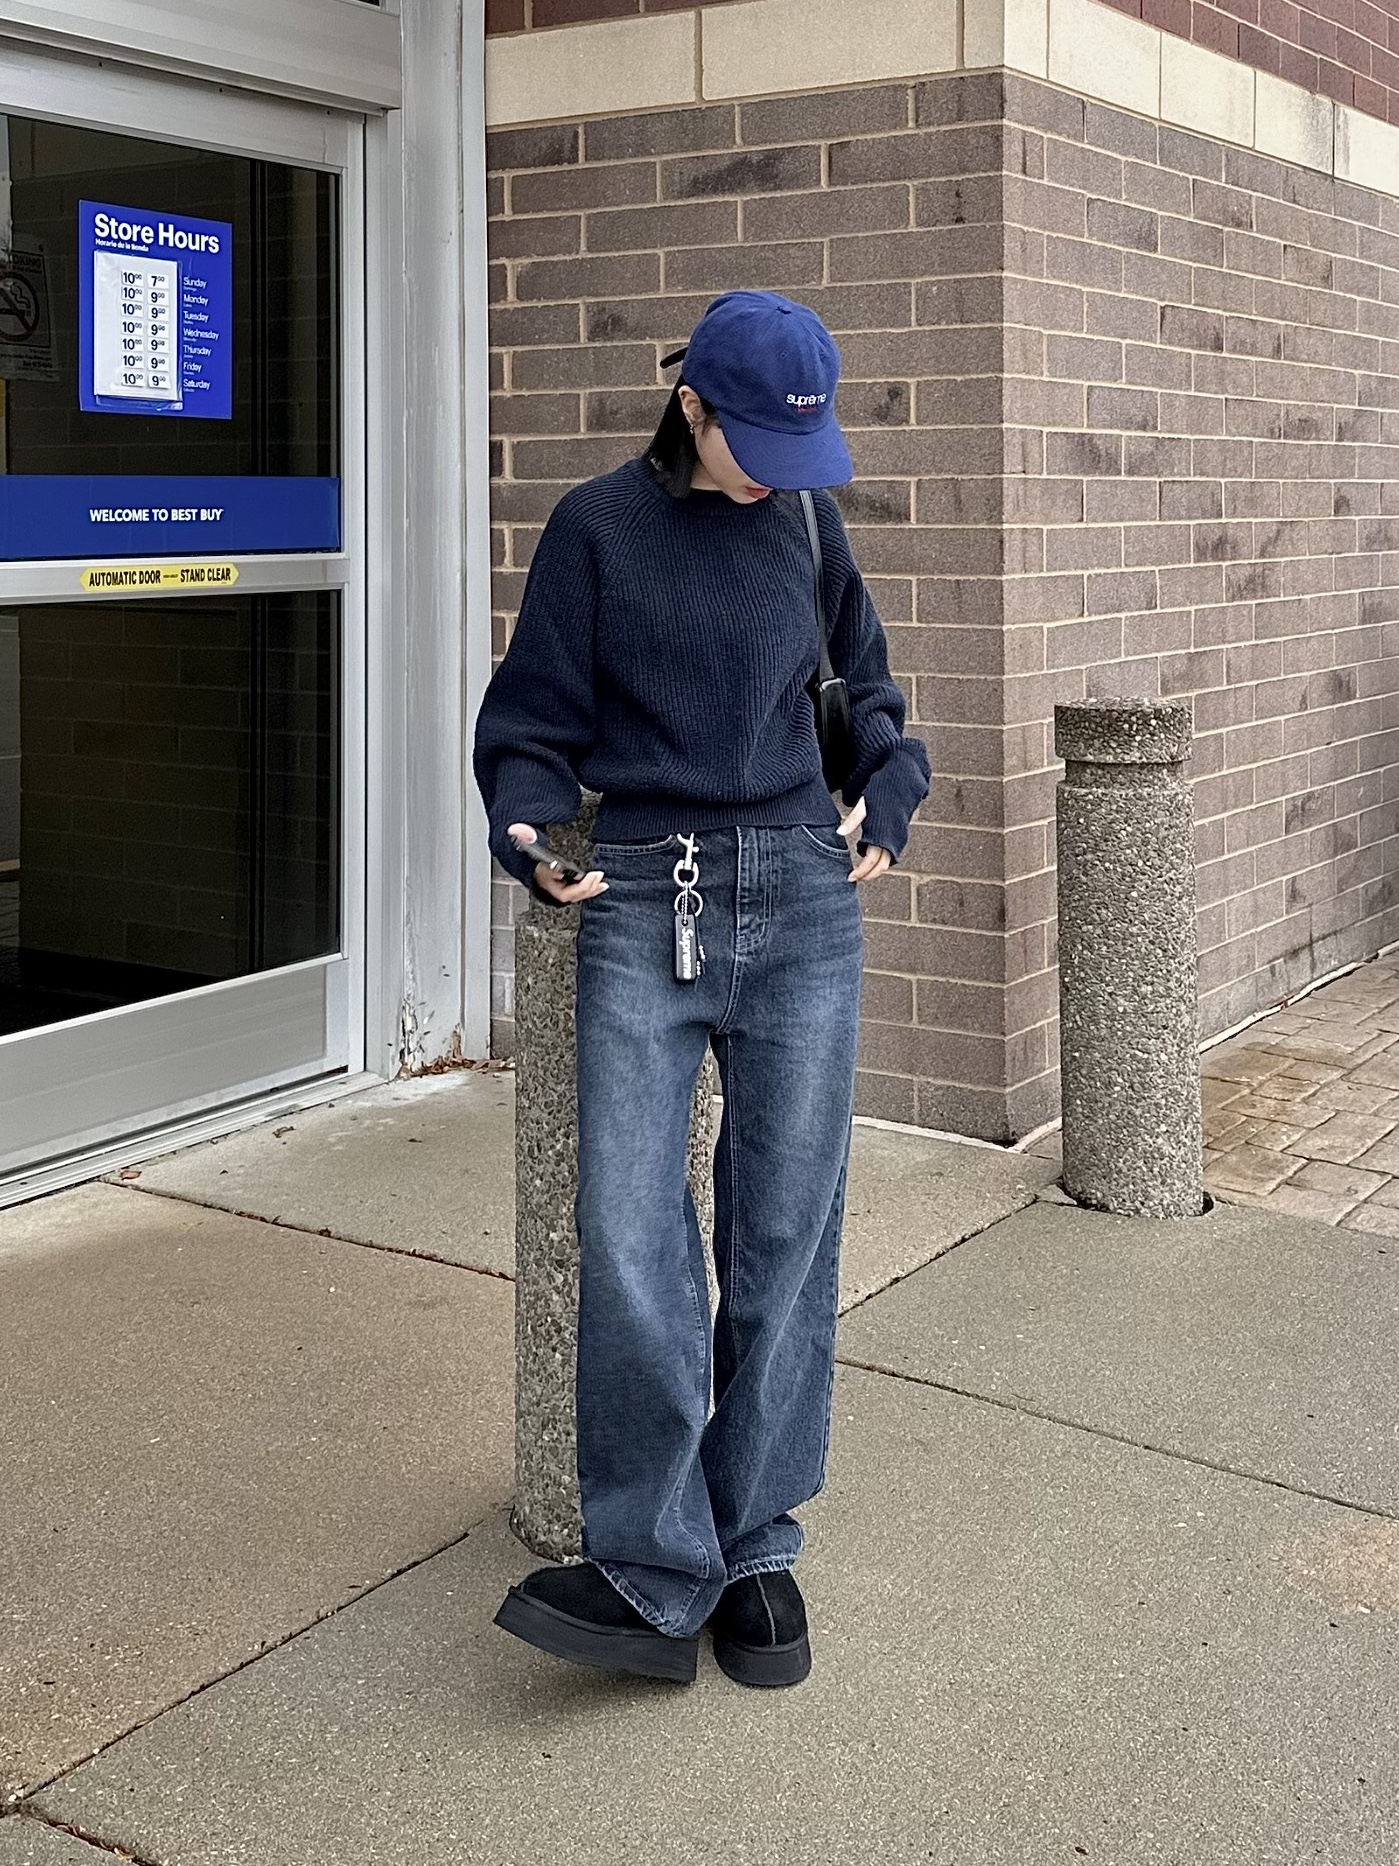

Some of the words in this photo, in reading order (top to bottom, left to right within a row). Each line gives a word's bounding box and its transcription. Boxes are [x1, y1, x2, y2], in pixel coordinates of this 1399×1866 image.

[94, 213, 155, 244] Store
[158, 222, 220, 254] Hours
[183, 276, 207, 289] Sunday
[183, 293, 209, 307] Monday
[183, 310, 209, 323] Tuesday
[183, 327, 219, 341] Wednesday
[183, 344, 212, 357] Thursday
[183, 361, 202, 373] Friday
[183, 378, 211, 390] Saturday
[89, 508, 149, 522] WELCOME
[152, 508, 169, 521] TO
[171, 508, 198, 521] BEST
[200, 508, 222, 521] BUY
[89, 570, 136, 587] AUTOMATIC
[138, 569, 161, 585] DOOR
[180, 568, 205, 583] STAND
[207, 567, 231, 582] CLEAR
[679, 927, 694, 979] Supreme
